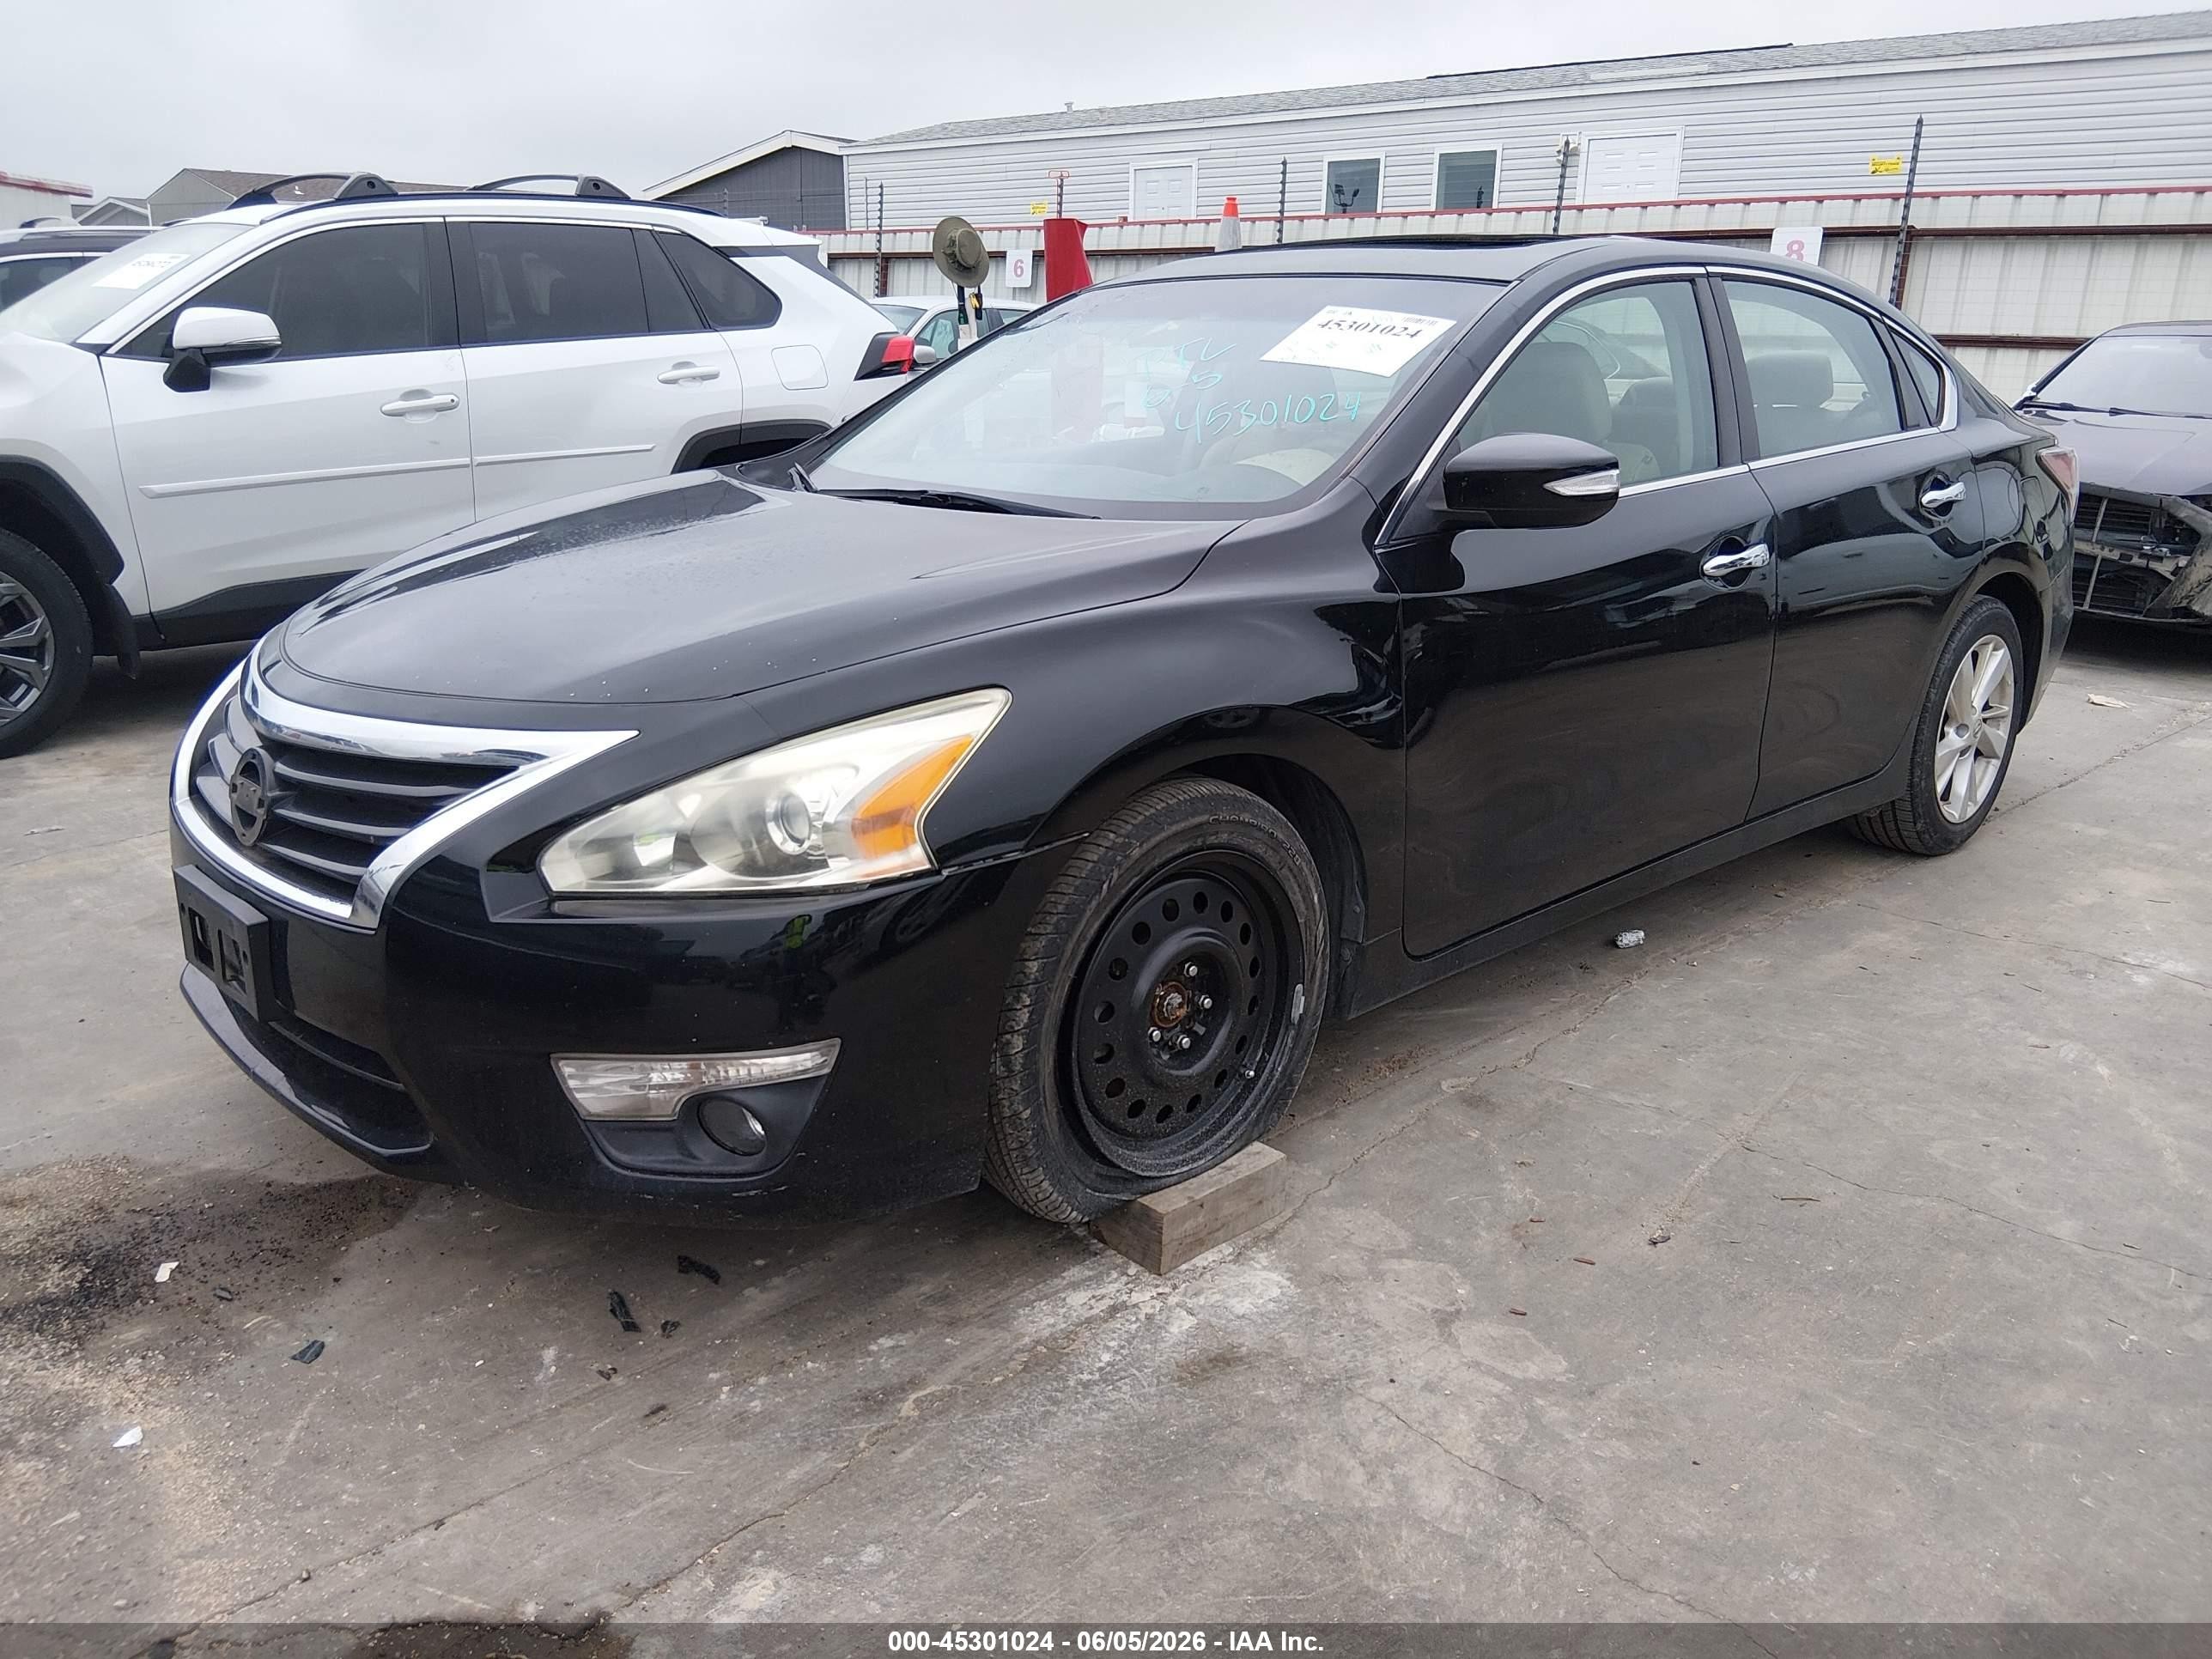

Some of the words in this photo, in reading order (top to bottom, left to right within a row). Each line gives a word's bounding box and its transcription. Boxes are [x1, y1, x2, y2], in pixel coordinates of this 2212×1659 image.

[1785, 240, 1805, 262] 8
[1013, 258, 1024, 278] 6
[1316, 318, 1424, 338] 45301024
[1175, 392, 1361, 443] 45301024
